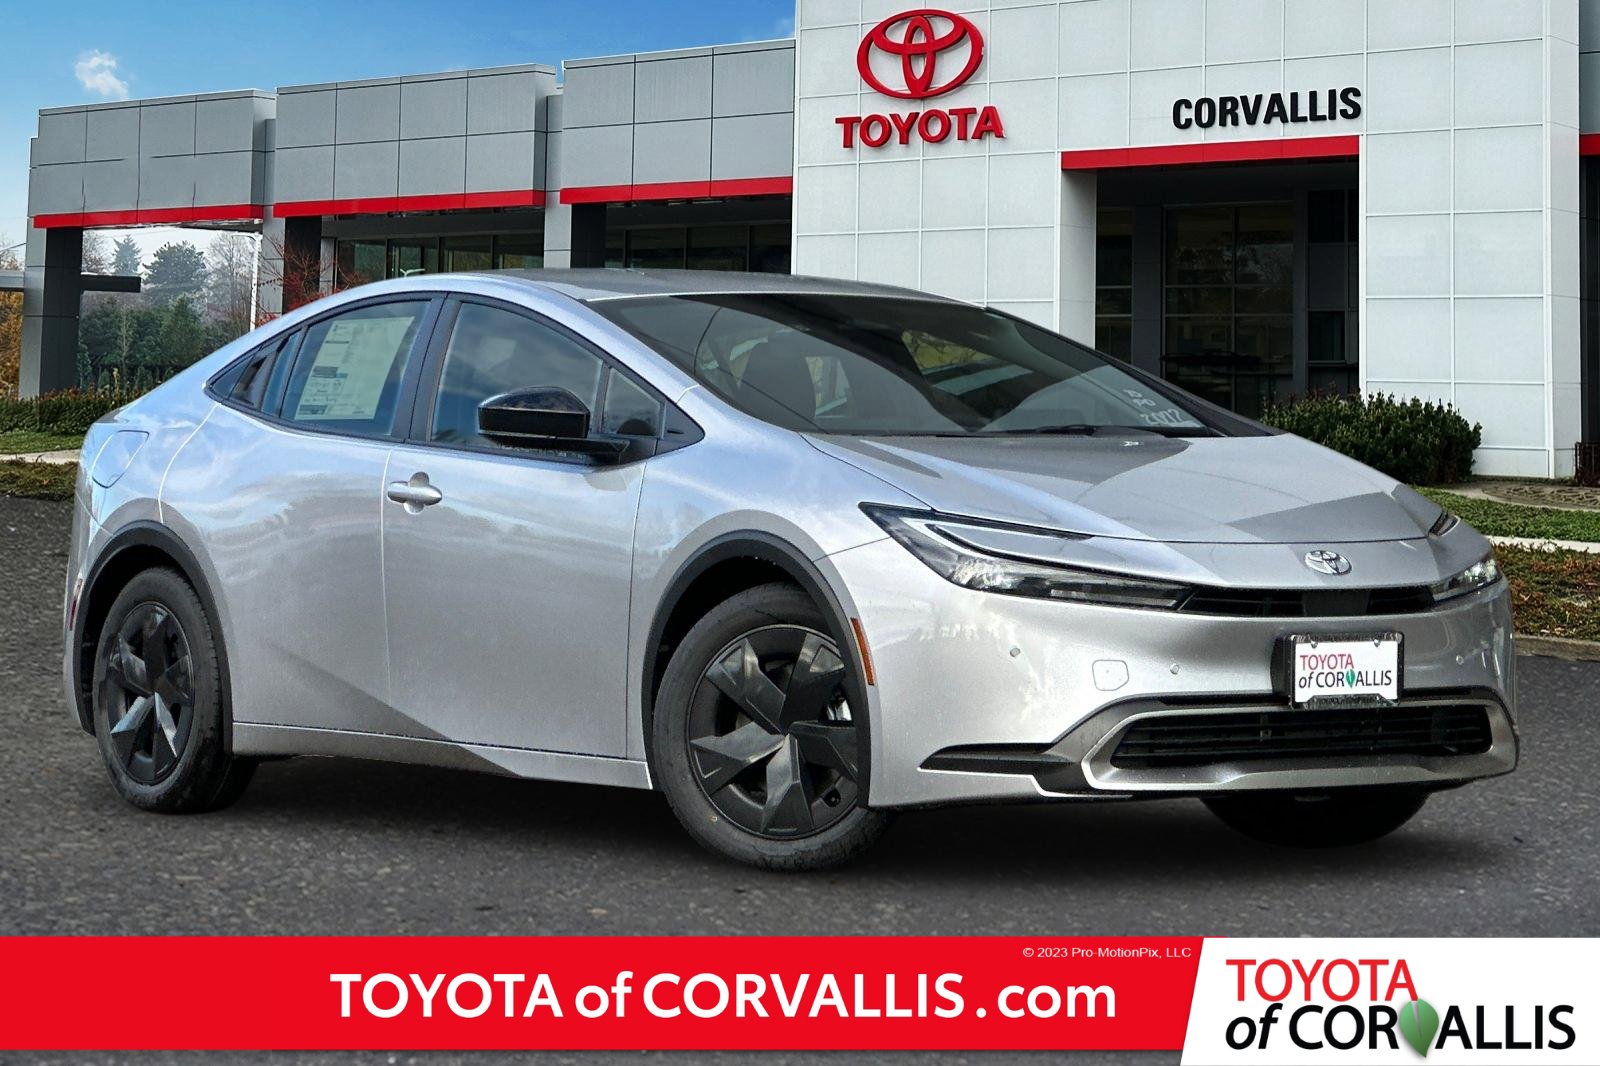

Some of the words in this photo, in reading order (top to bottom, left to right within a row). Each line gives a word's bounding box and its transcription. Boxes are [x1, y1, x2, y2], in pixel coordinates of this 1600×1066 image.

[1173, 86, 1362, 130] CORVALLIS
[836, 105, 1005, 149] TOYOTA
[1300, 653, 1355, 671] TOYOTA
[1298, 671, 1314, 689] of
